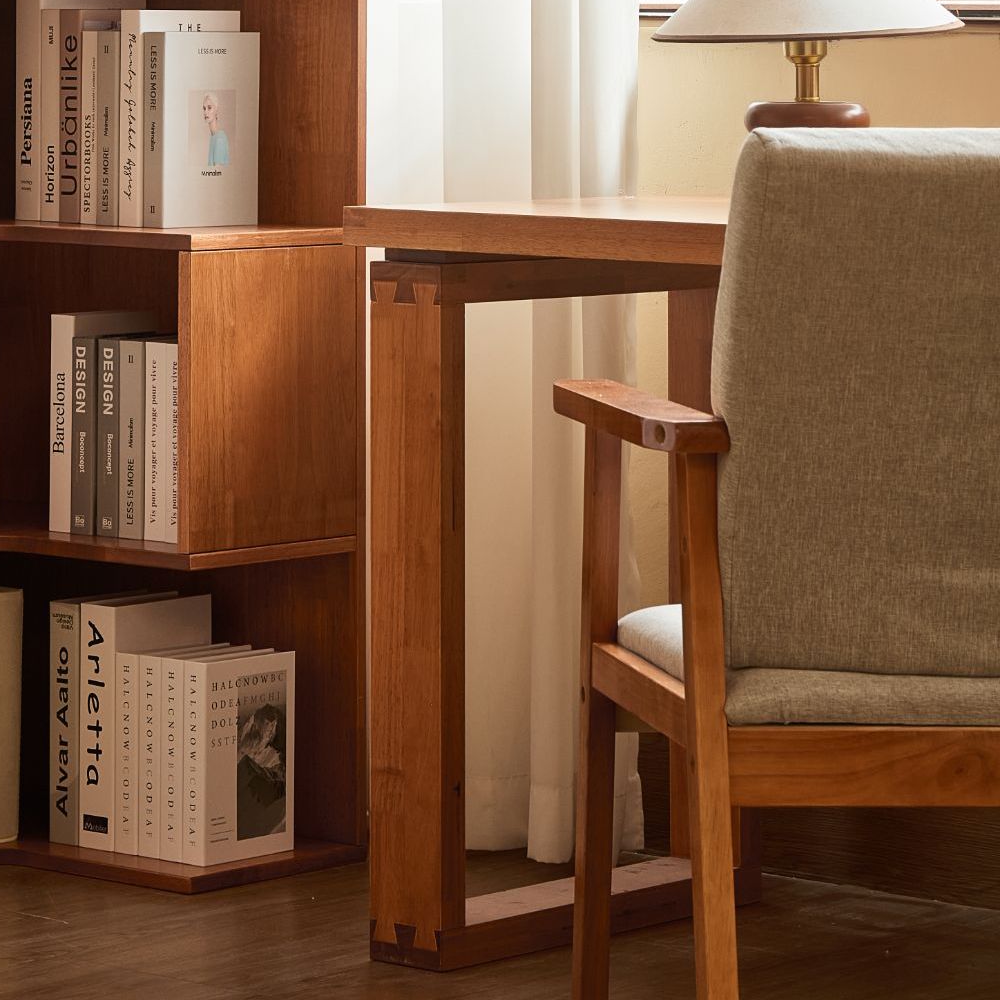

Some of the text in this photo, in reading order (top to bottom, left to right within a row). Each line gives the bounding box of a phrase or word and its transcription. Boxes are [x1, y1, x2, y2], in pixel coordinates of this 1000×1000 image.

[178, 23, 202, 32] THE
[149, 82, 157, 111] MORE
[150, 71, 157, 81] IS
[20, 77, 33, 167] Persiana
[61, 35, 77, 196] Urbänlike
[45, 145, 55, 203] Horizon
[102, 178, 109, 187] IS
[75, 346, 86, 414] DESIGN
[103, 347, 114, 416] DESIGN
[53, 373, 66, 455] Barcelona
[106, 433, 114, 475] Boconcept
[151, 438, 157, 448] et
[126, 501, 134, 525] LESS
[127, 489, 134, 499] IS
[170, 511, 178, 526] Vis
[87, 620, 105, 786] Arletta
[56, 646, 69, 818] Alvar Aalto
